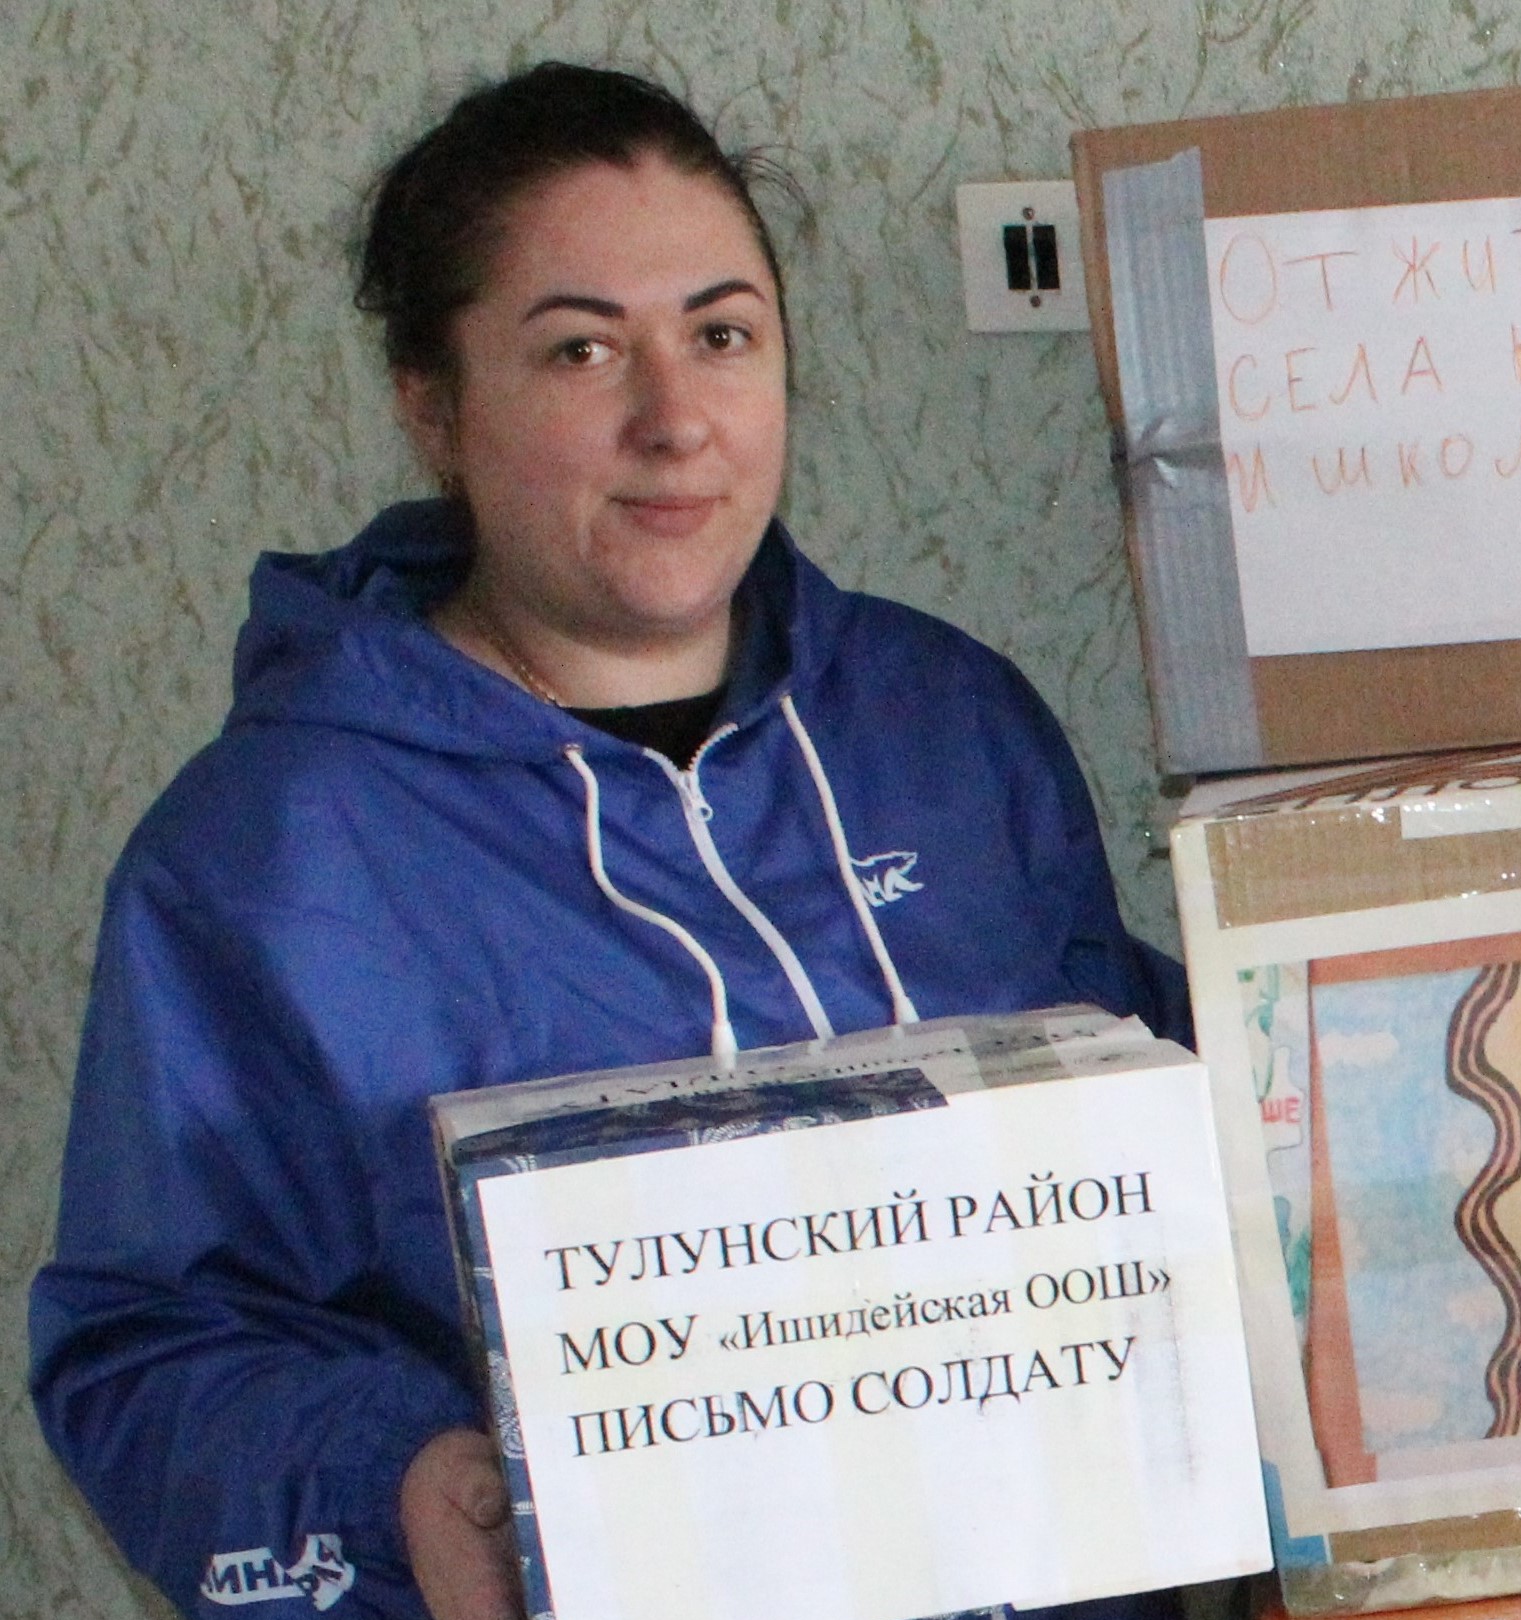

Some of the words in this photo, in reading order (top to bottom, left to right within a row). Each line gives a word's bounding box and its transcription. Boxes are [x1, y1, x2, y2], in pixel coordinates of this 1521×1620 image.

[1229, 337, 1443, 421] СЕЛА
[1224, 449, 1275, 514] И
[545, 1191, 930, 1291] ТУЛУНСКИЙ
[948, 1171, 1157, 1239] РАЙОН
[556, 1314, 701, 1376] МОУ
[718, 1285, 1012, 1354] «Ишидейская
[1024, 1260, 1172, 1310] ООШ»
[571, 1380, 835, 1458] ПИСЬМО
[850, 1336, 1140, 1416] СОЛДАТУ
